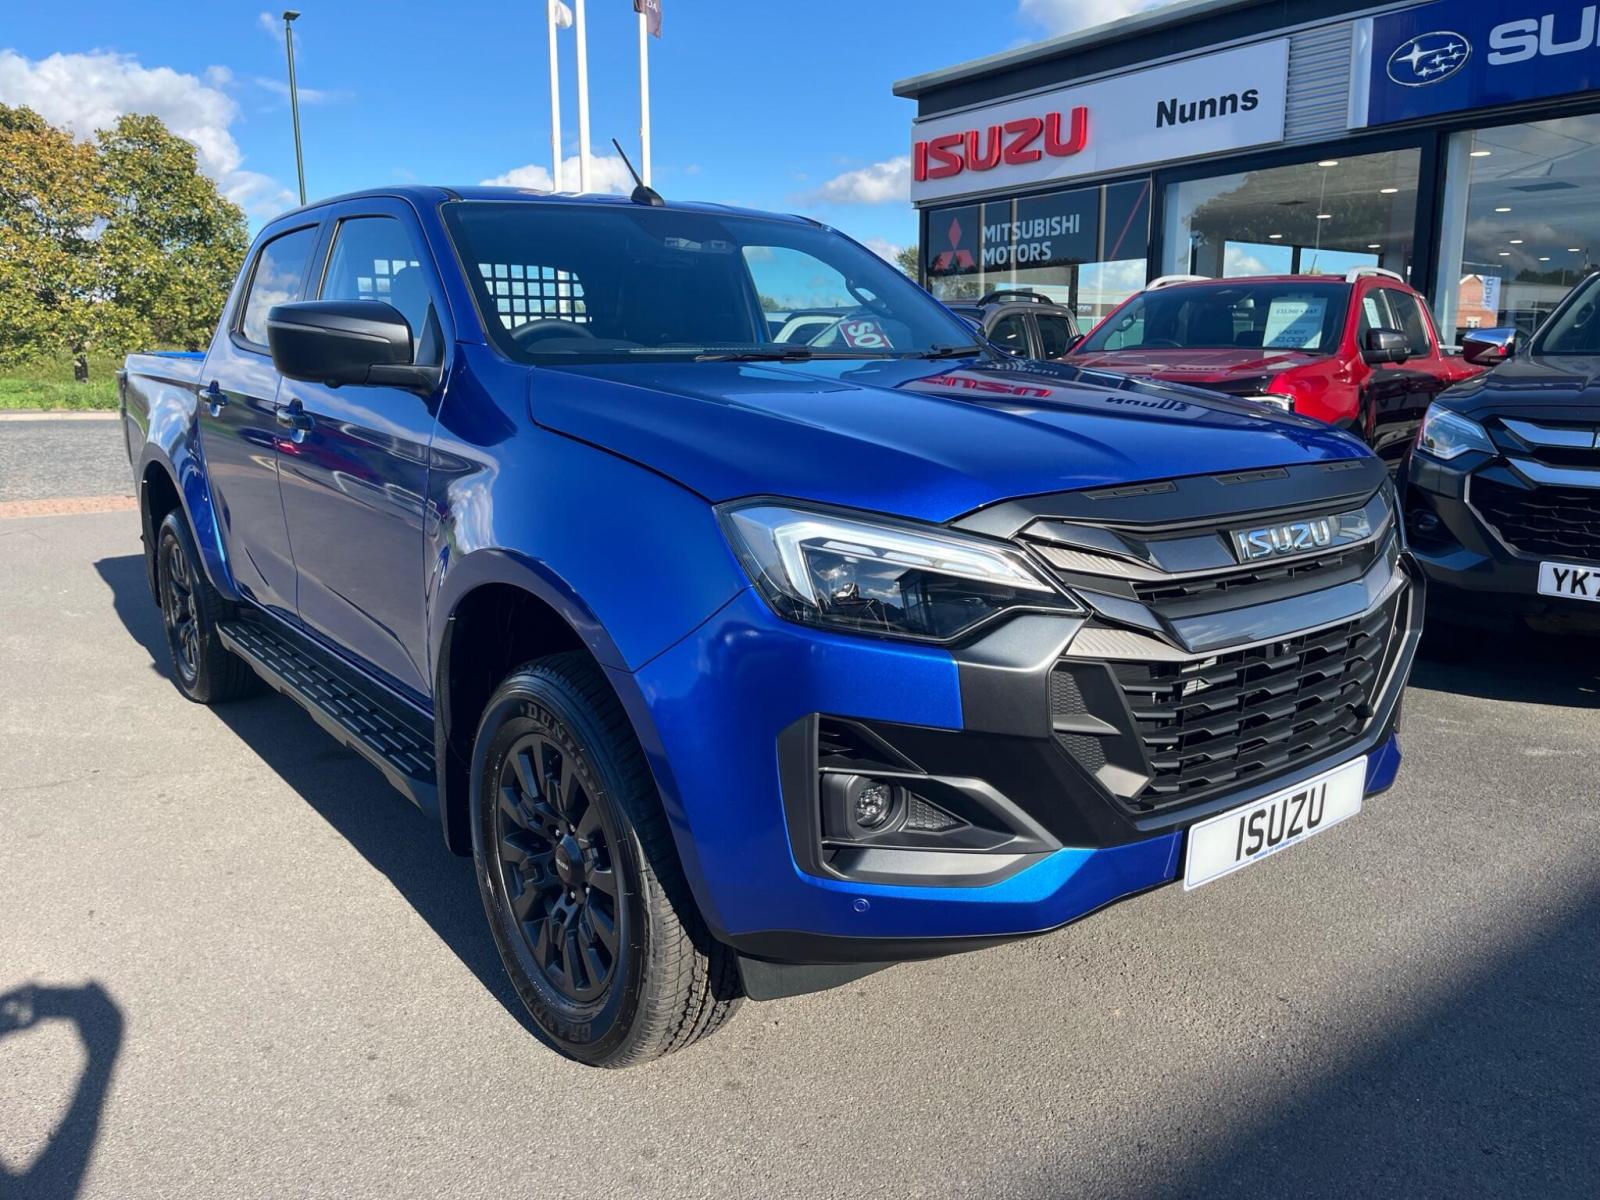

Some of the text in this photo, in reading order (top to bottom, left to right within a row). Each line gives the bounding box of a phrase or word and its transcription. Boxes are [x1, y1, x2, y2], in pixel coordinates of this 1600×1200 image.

[1487, 5, 1600, 65] SU
[1156, 89, 1258, 128] Nunns
[914, 106, 1087, 181] ISUZU
[981, 214, 1080, 243] MITSUBISHI
[981, 241, 1051, 266] MOTORS
[1238, 519, 1331, 560] ISUZU
[1236, 782, 1327, 862] ISUZU
